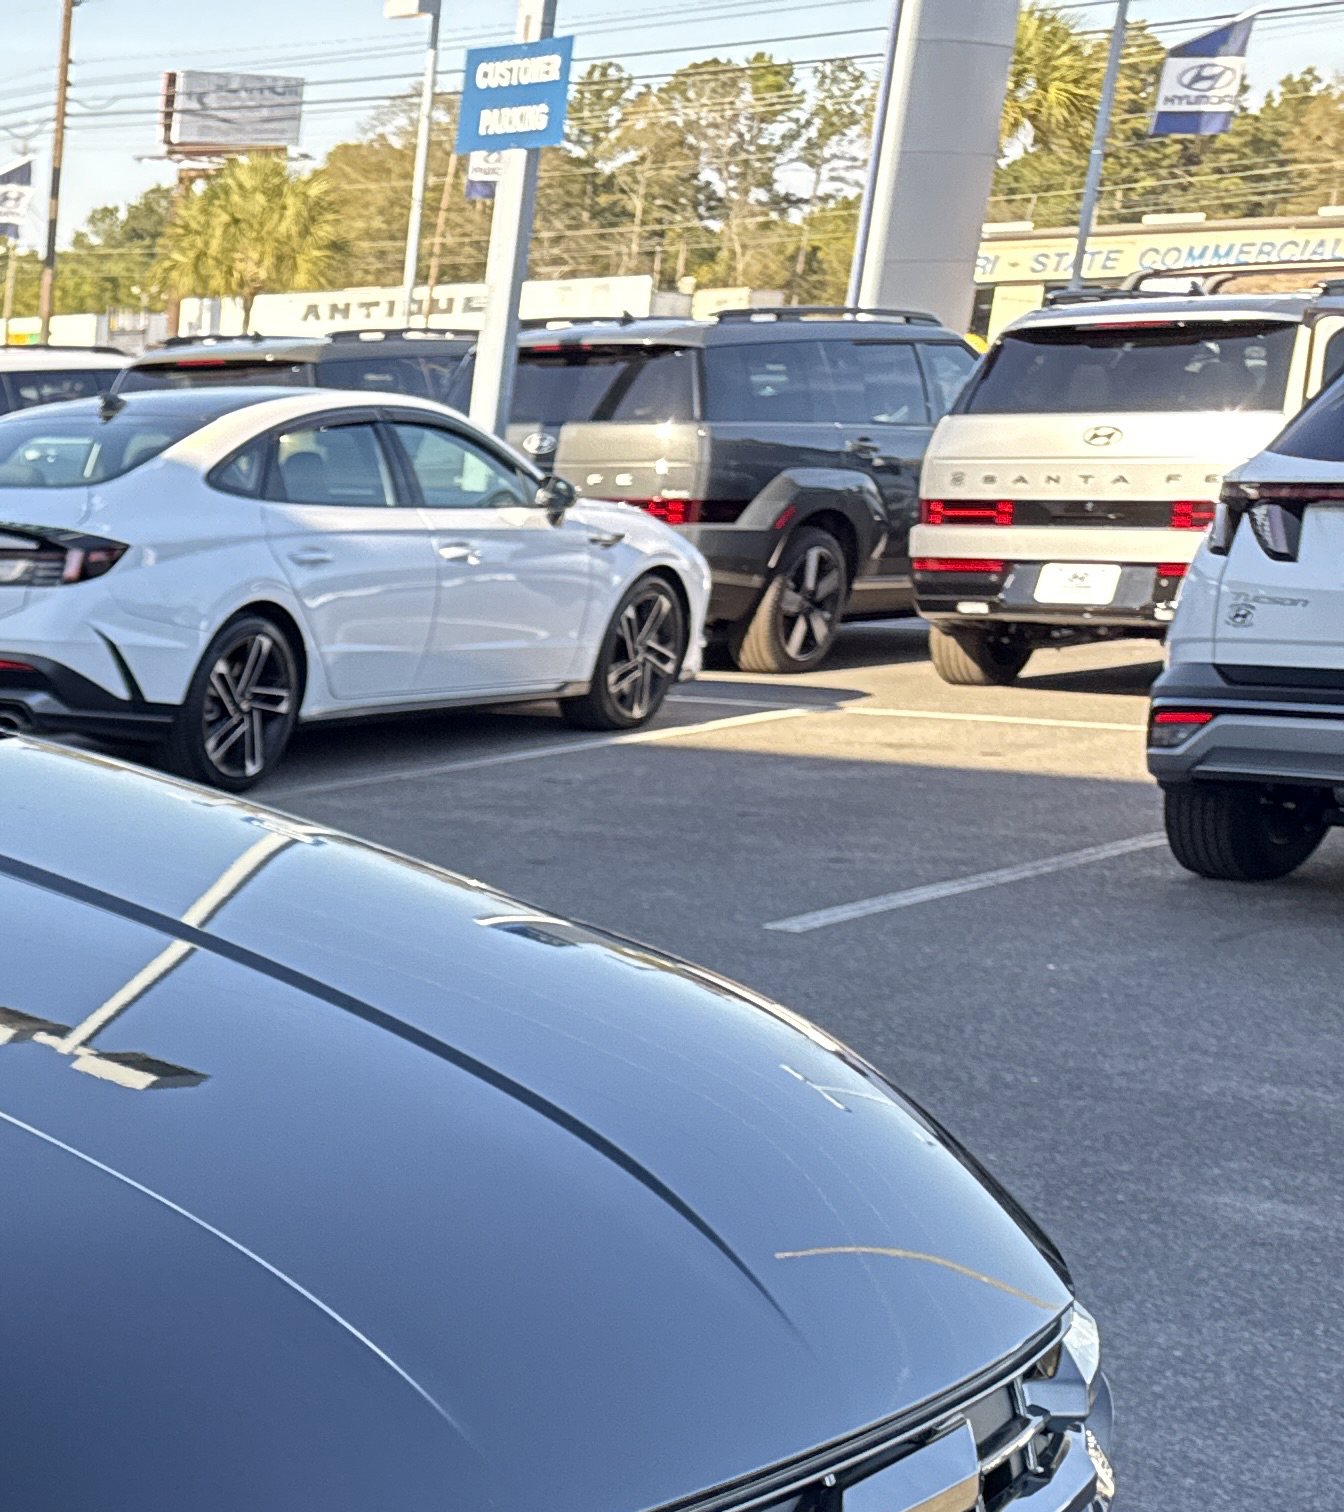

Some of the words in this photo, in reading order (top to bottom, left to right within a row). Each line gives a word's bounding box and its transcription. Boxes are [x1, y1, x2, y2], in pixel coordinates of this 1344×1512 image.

[476, 54, 562, 89] CUSTOMER
[1163, 94, 1234, 106] HYUNDA
[478, 103, 550, 136] PARKING
[1138, 238, 1344, 270] COMMERCIAL
[981, 474, 1131, 485] SANTA
[1165, 473, 1222, 484] FE
